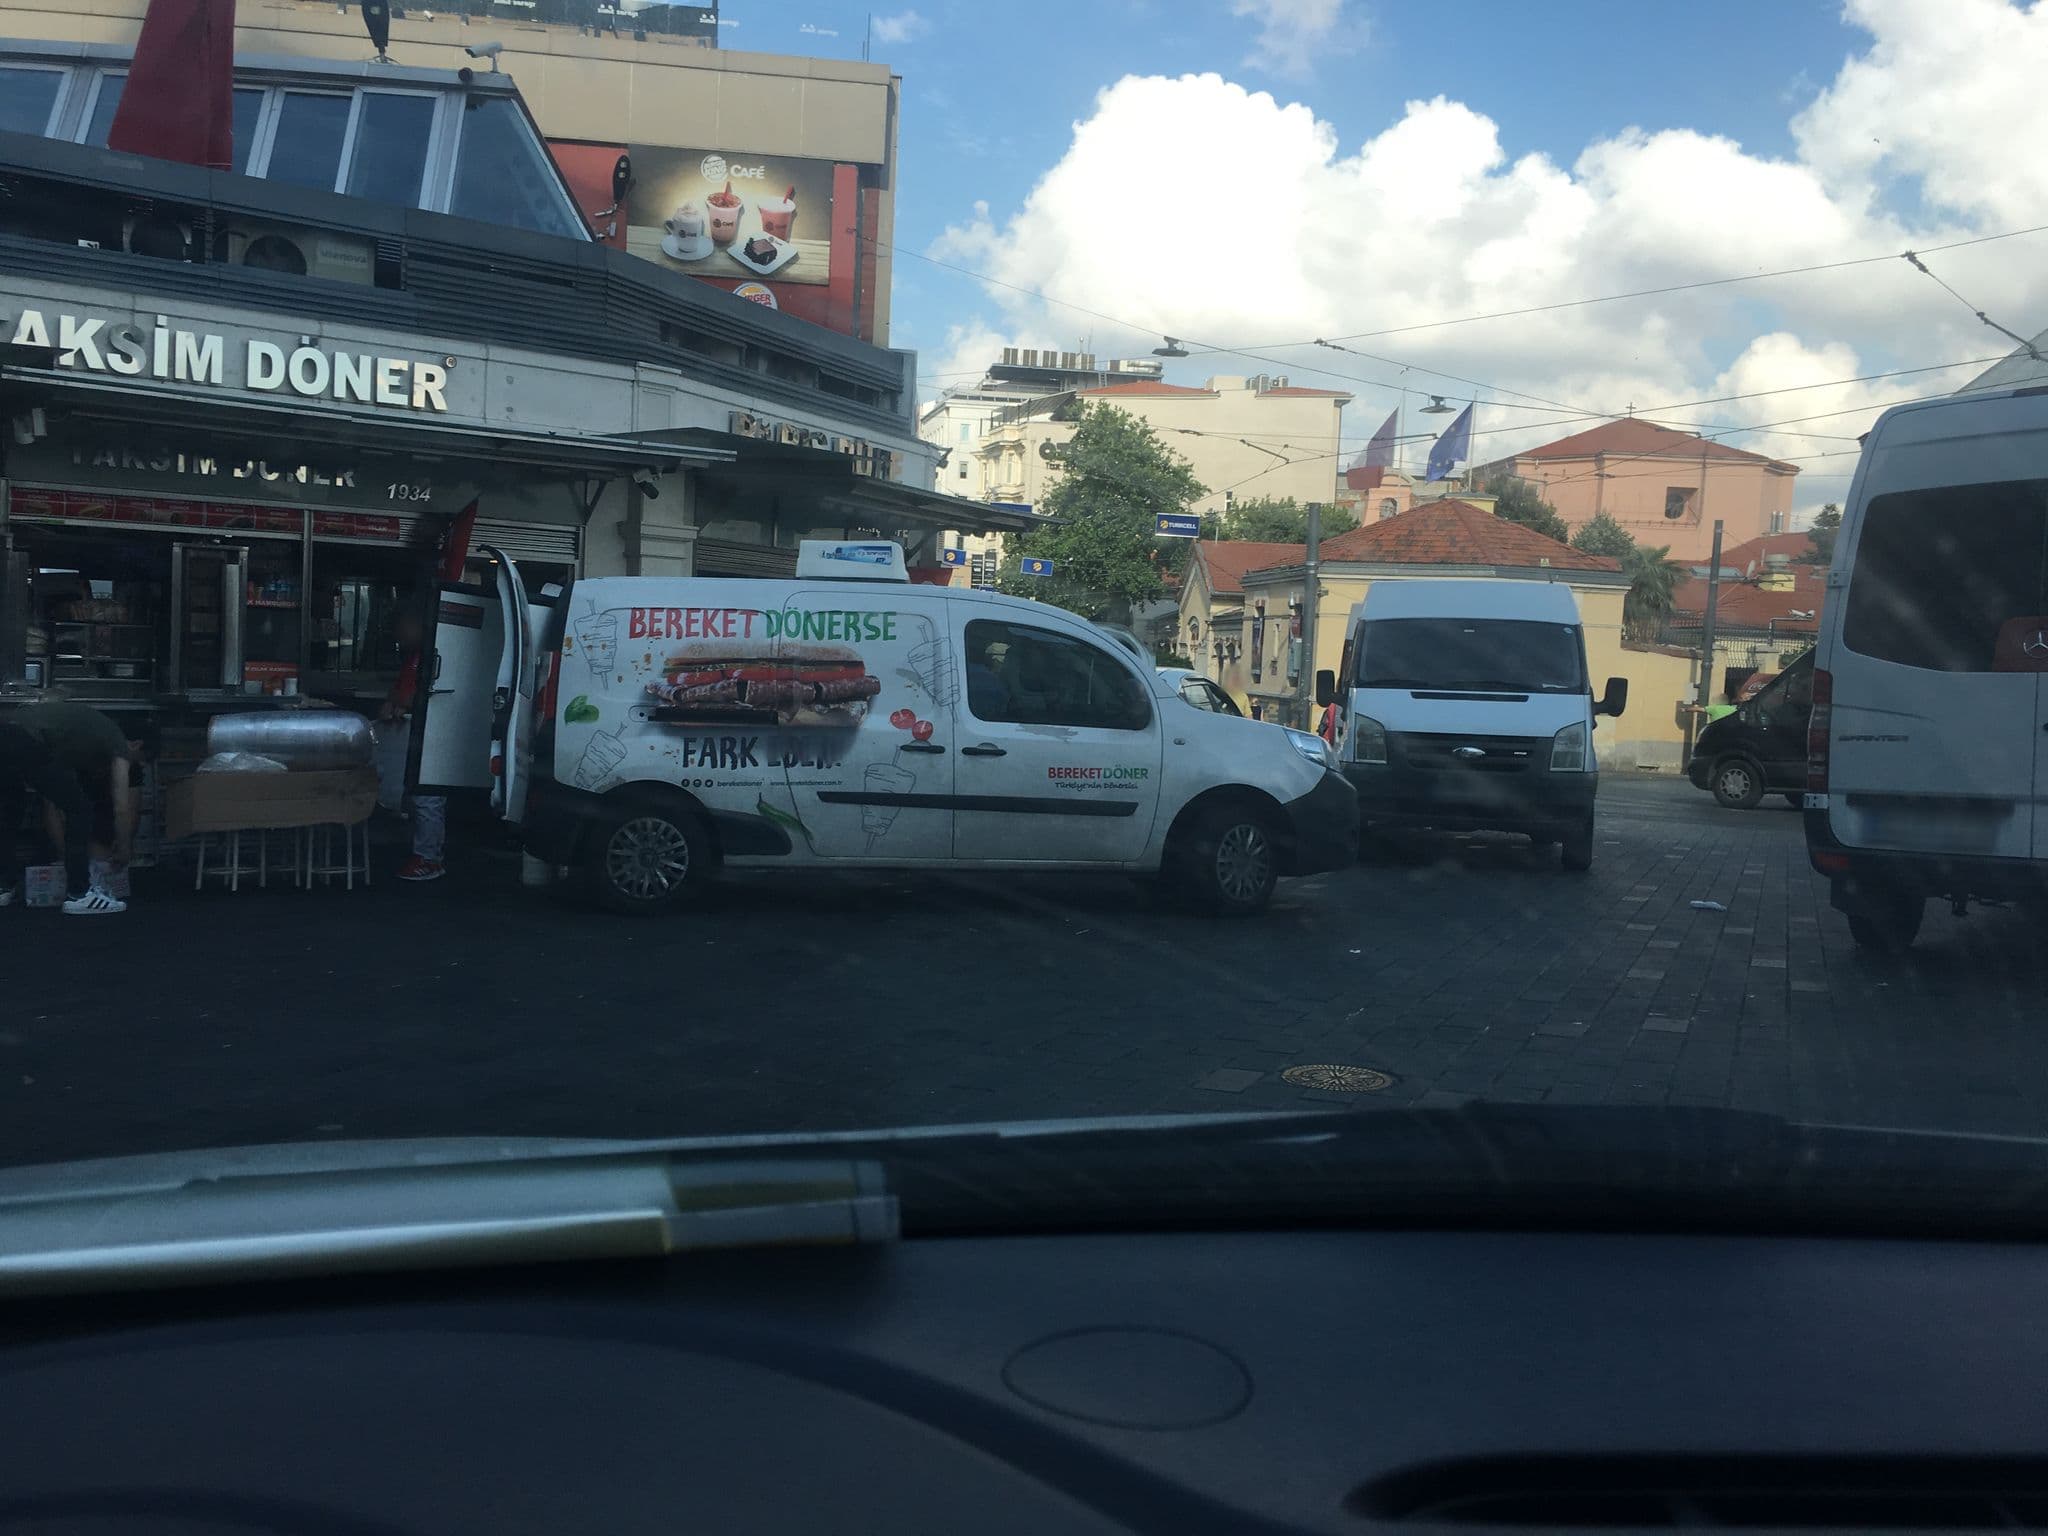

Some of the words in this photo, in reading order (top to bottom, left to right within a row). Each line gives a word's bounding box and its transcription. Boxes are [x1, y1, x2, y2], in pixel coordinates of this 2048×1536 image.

[0, 309, 223, 384] AKSİM
[247, 335, 448, 411] DÖNER
[387, 483, 431, 502] 1934
[1168, 521, 1197, 530] TURKCELL
[629, 607, 759, 640] BEREKET
[766, 607, 897, 642] DÖNERSE
[682, 736, 759, 770] FARK
